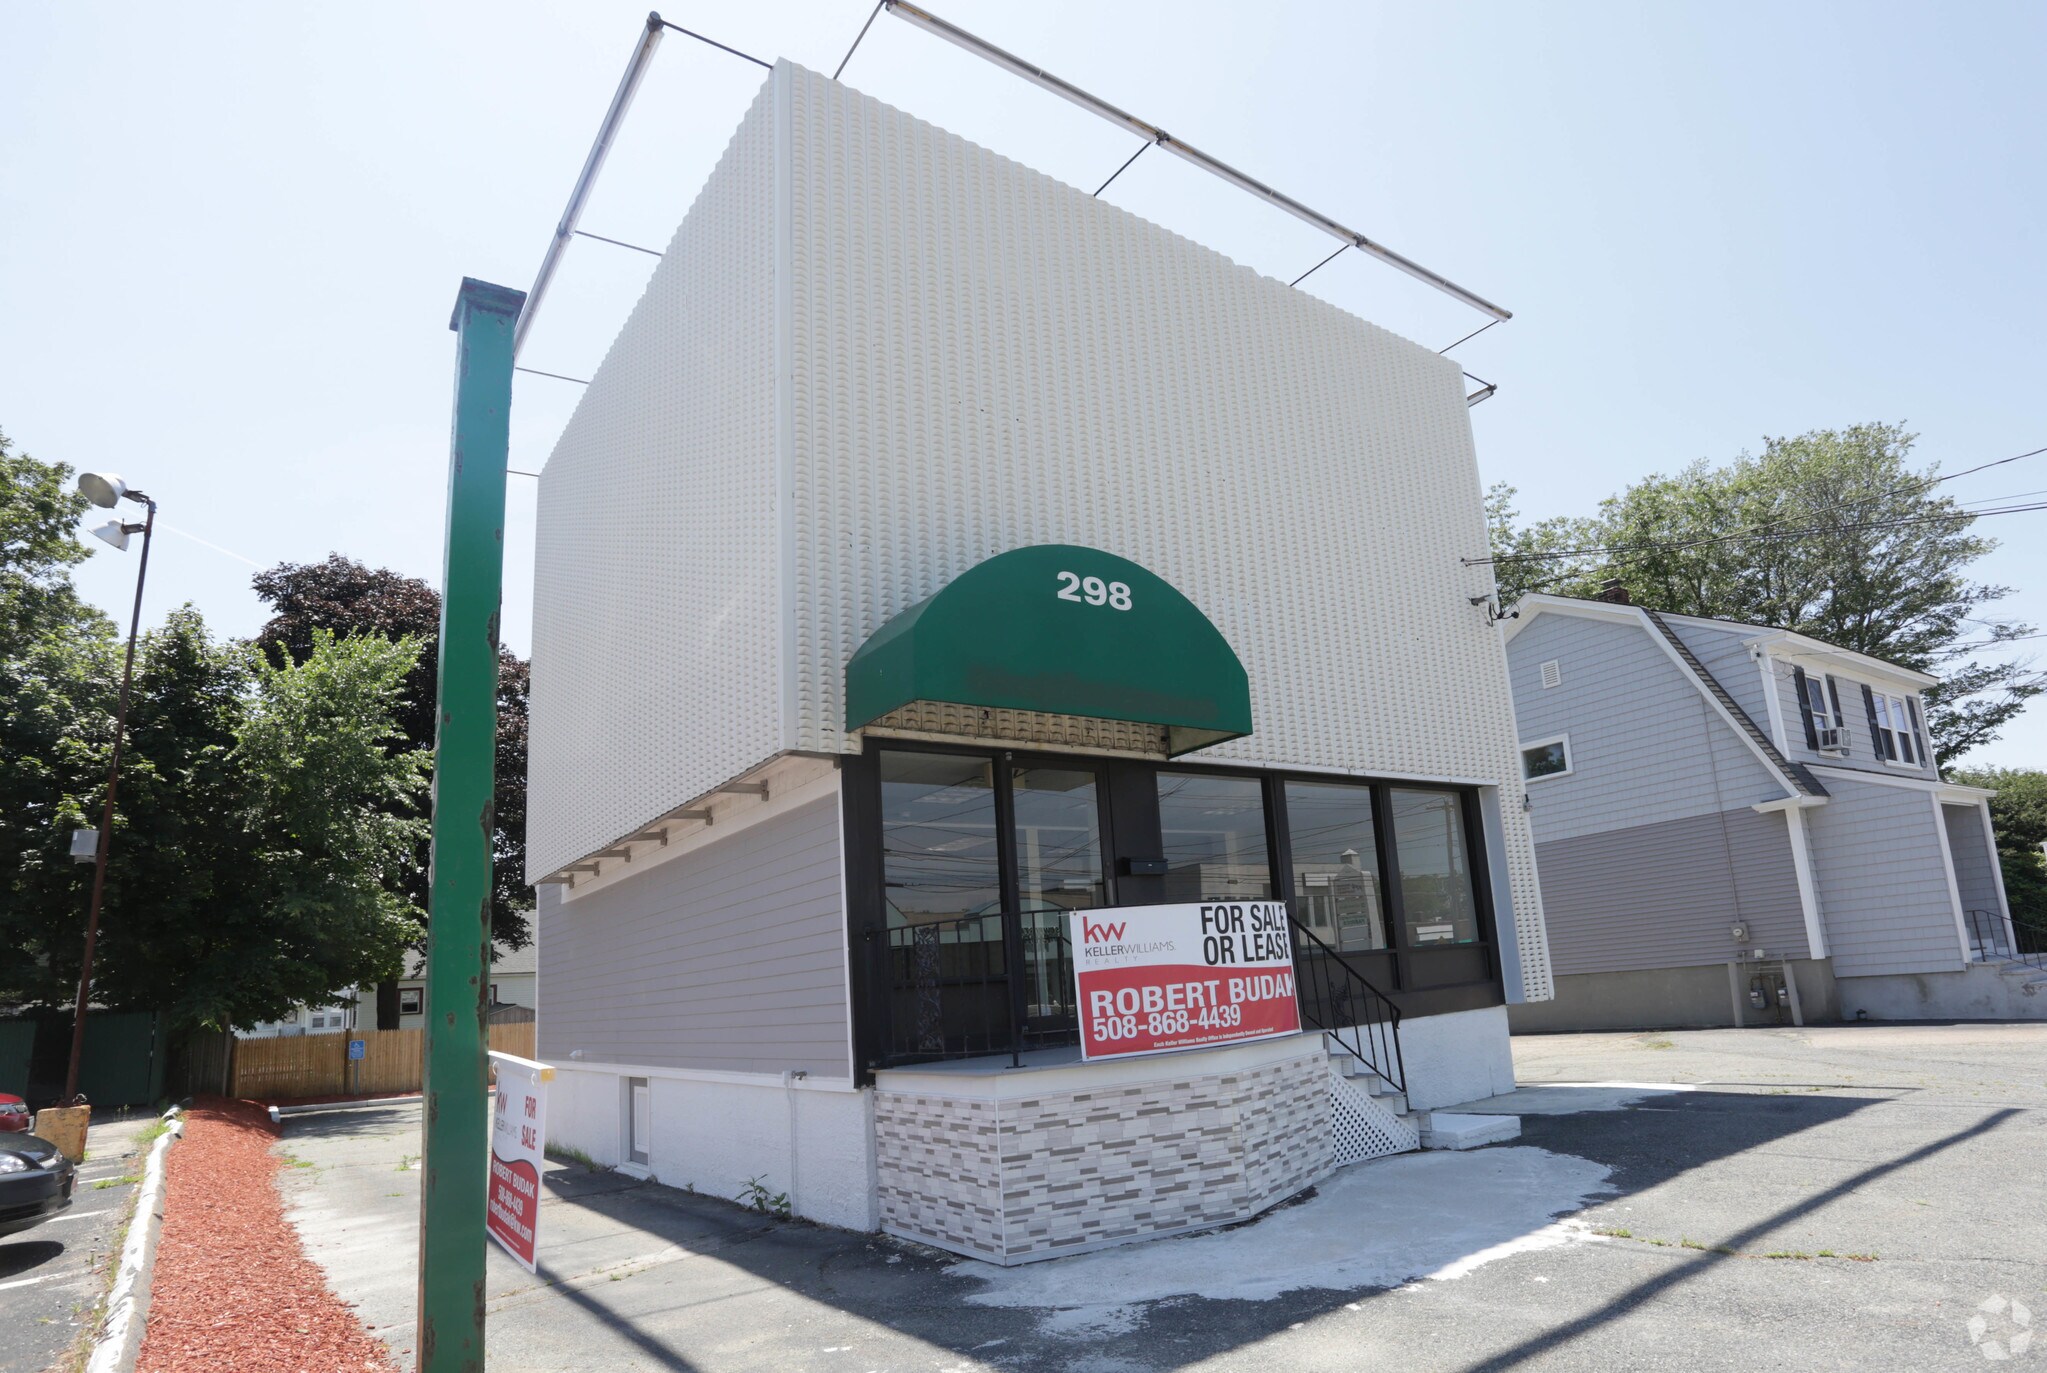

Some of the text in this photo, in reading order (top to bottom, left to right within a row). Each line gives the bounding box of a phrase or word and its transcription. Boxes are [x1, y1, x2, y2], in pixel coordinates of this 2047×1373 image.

[1057, 571, 1132, 611] 298
[1200, 904, 1286, 935] FOR SALE
[1085, 955, 1138, 967] REALTY
[1203, 932, 1290, 966] OR LEASE
[1090, 979, 1220, 1018] ROBERT
[1093, 1004, 1241, 1042] 508-868-4439
[524, 1095, 537, 1119] FOR
[521, 1124, 537, 1151] SALE
[492, 1159, 535, 1200] ROBERT BUDAK
